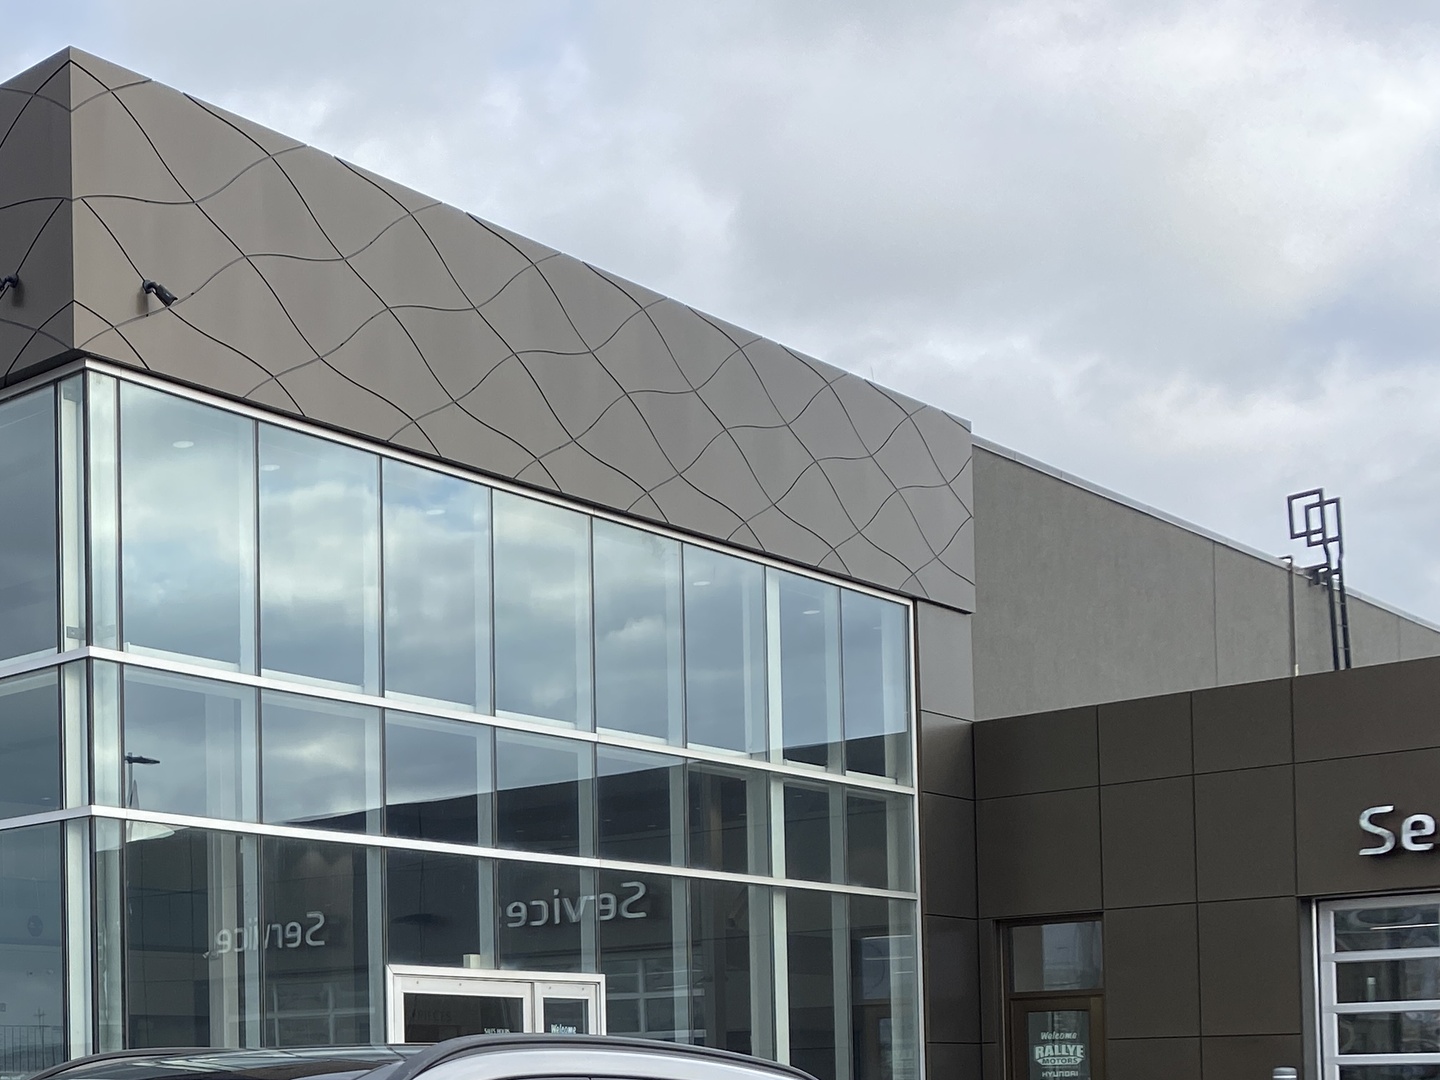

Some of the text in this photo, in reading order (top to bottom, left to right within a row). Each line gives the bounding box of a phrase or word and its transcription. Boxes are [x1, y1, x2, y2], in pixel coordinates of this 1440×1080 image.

[1358, 805, 1436, 856] Se
[1040, 1031, 1078, 1040] Welcome
[1035, 1044, 1084, 1060] RALLYE
[1041, 1070, 1079, 1078] HYUNDAI
